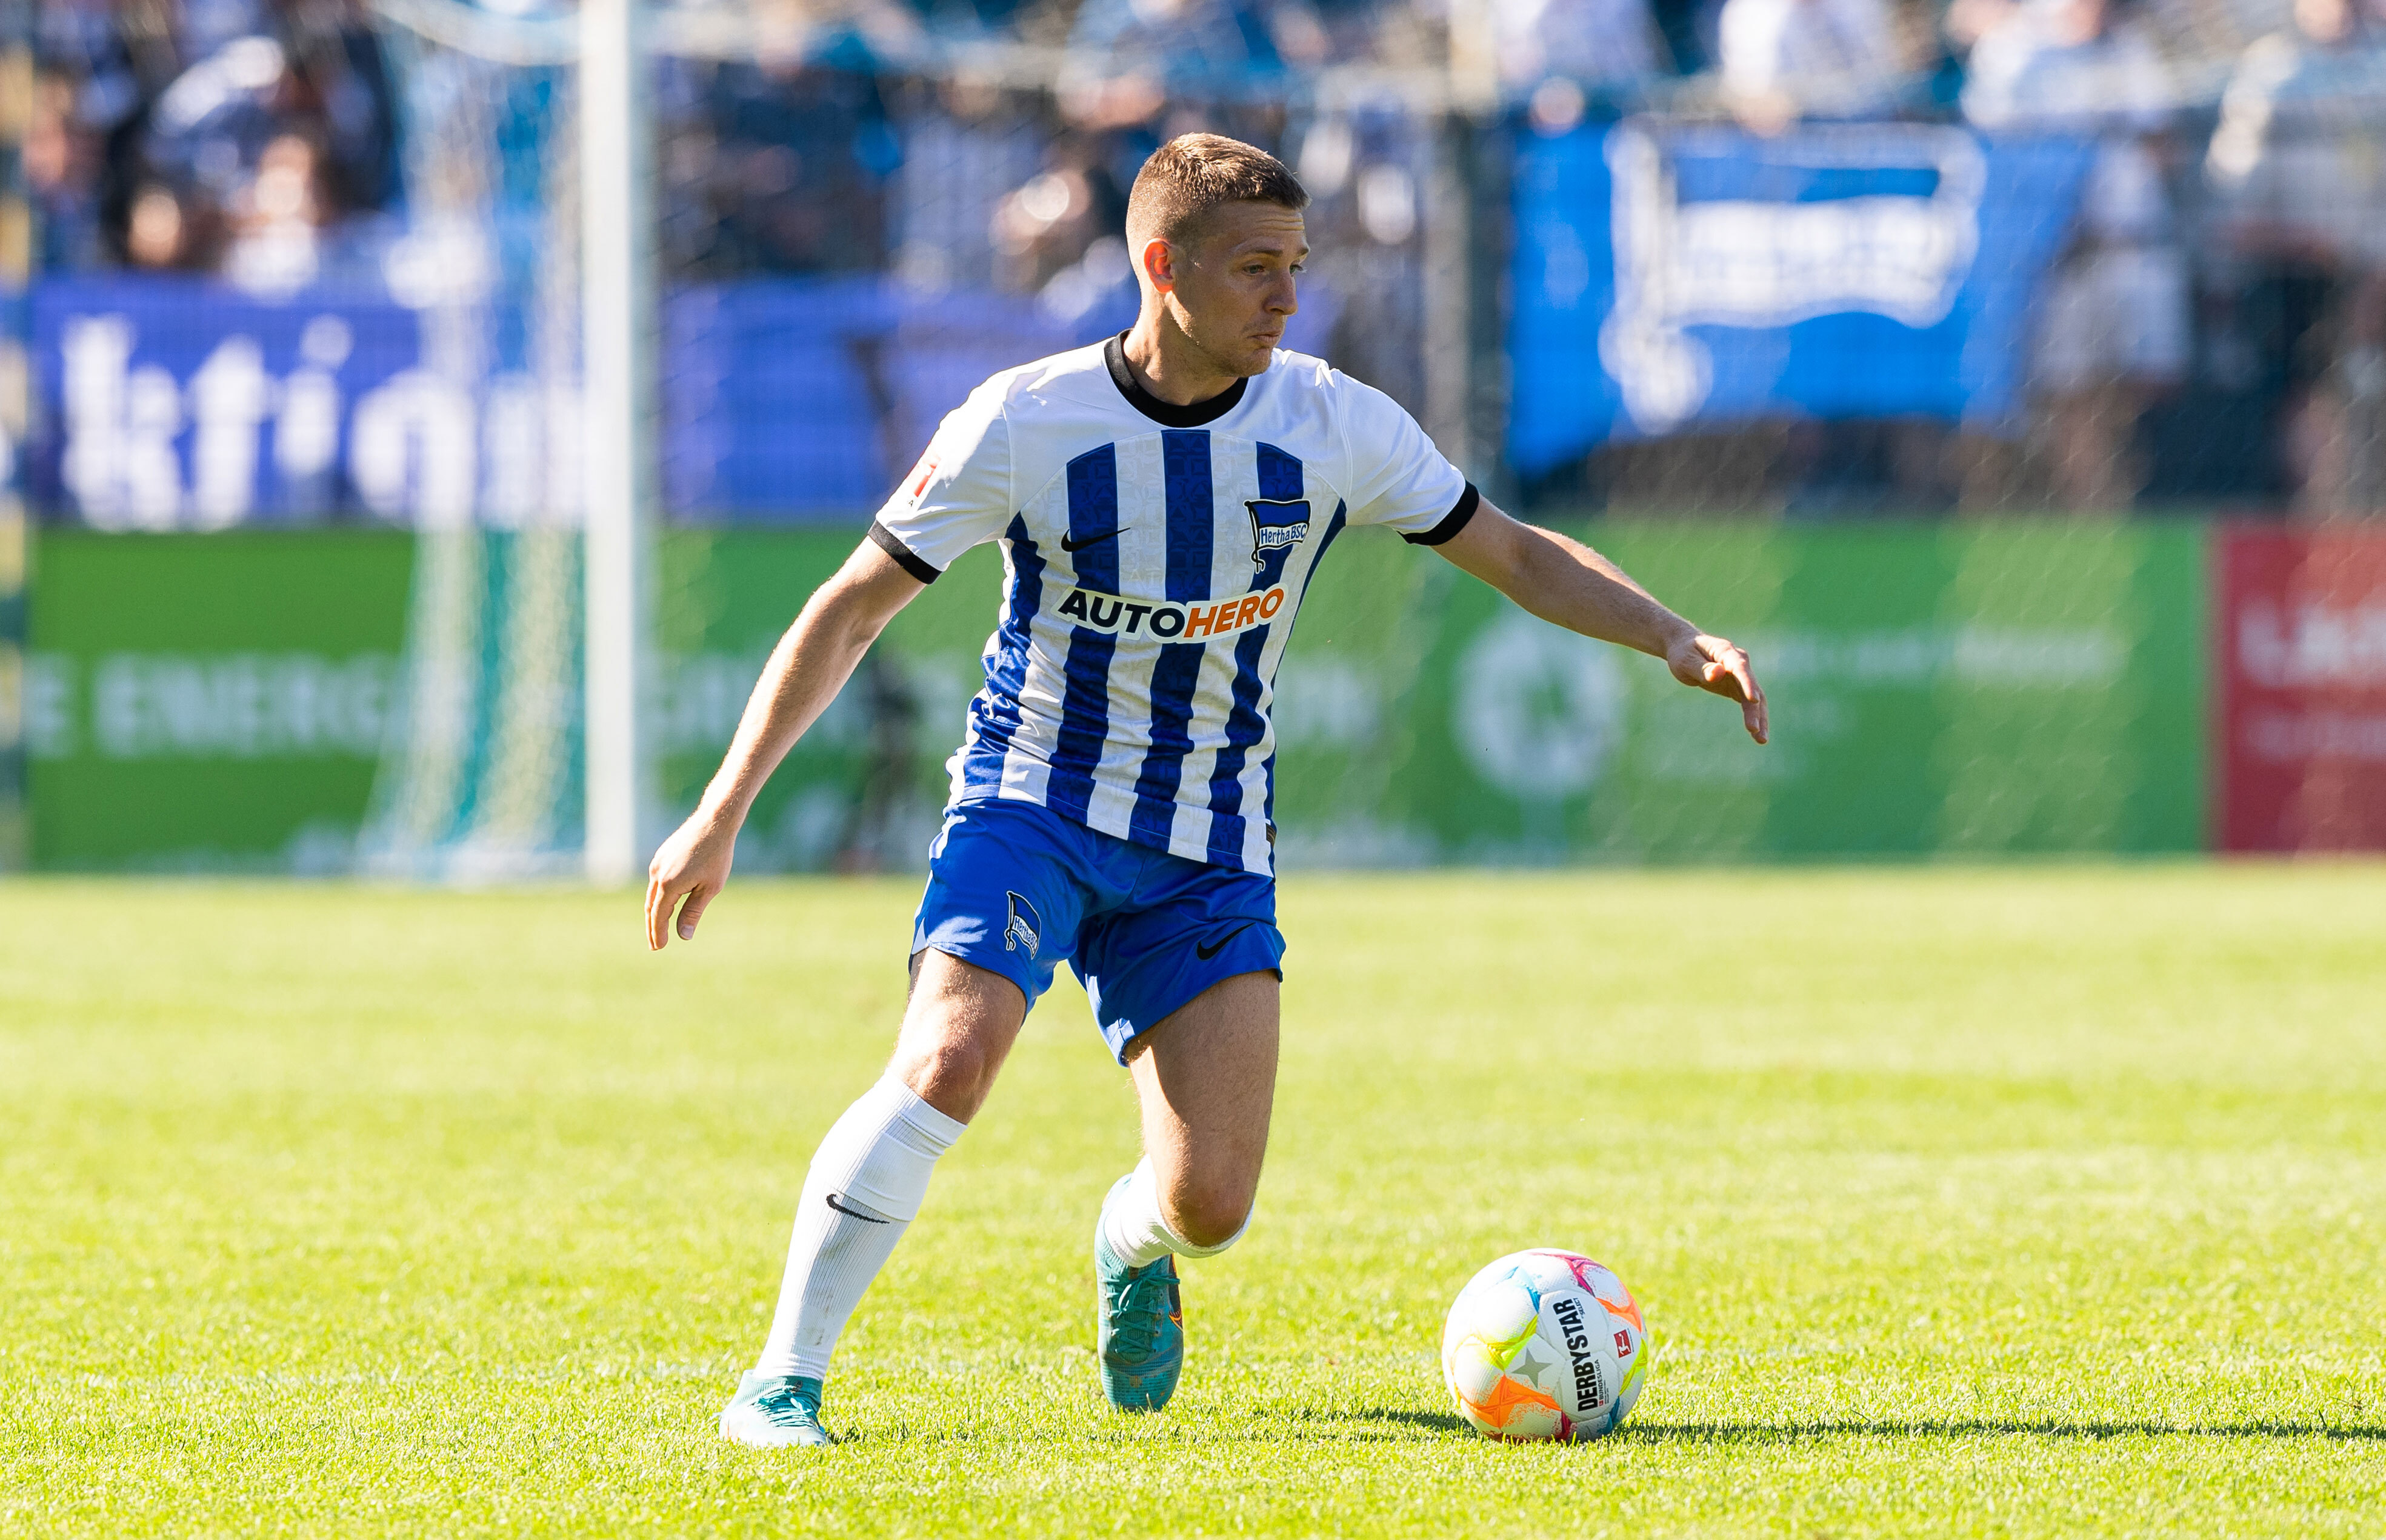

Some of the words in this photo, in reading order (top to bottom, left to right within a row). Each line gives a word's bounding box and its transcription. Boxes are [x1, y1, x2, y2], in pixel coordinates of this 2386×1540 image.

[1261, 528, 1290, 544] Hertha
[1291, 524, 1307, 539] BSC
[1058, 588, 1285, 638] AUTOHERO
[1552, 1298, 1598, 1412] DERBYSTAR
[1595, 1359, 1604, 1400] BUNDESLIGA
